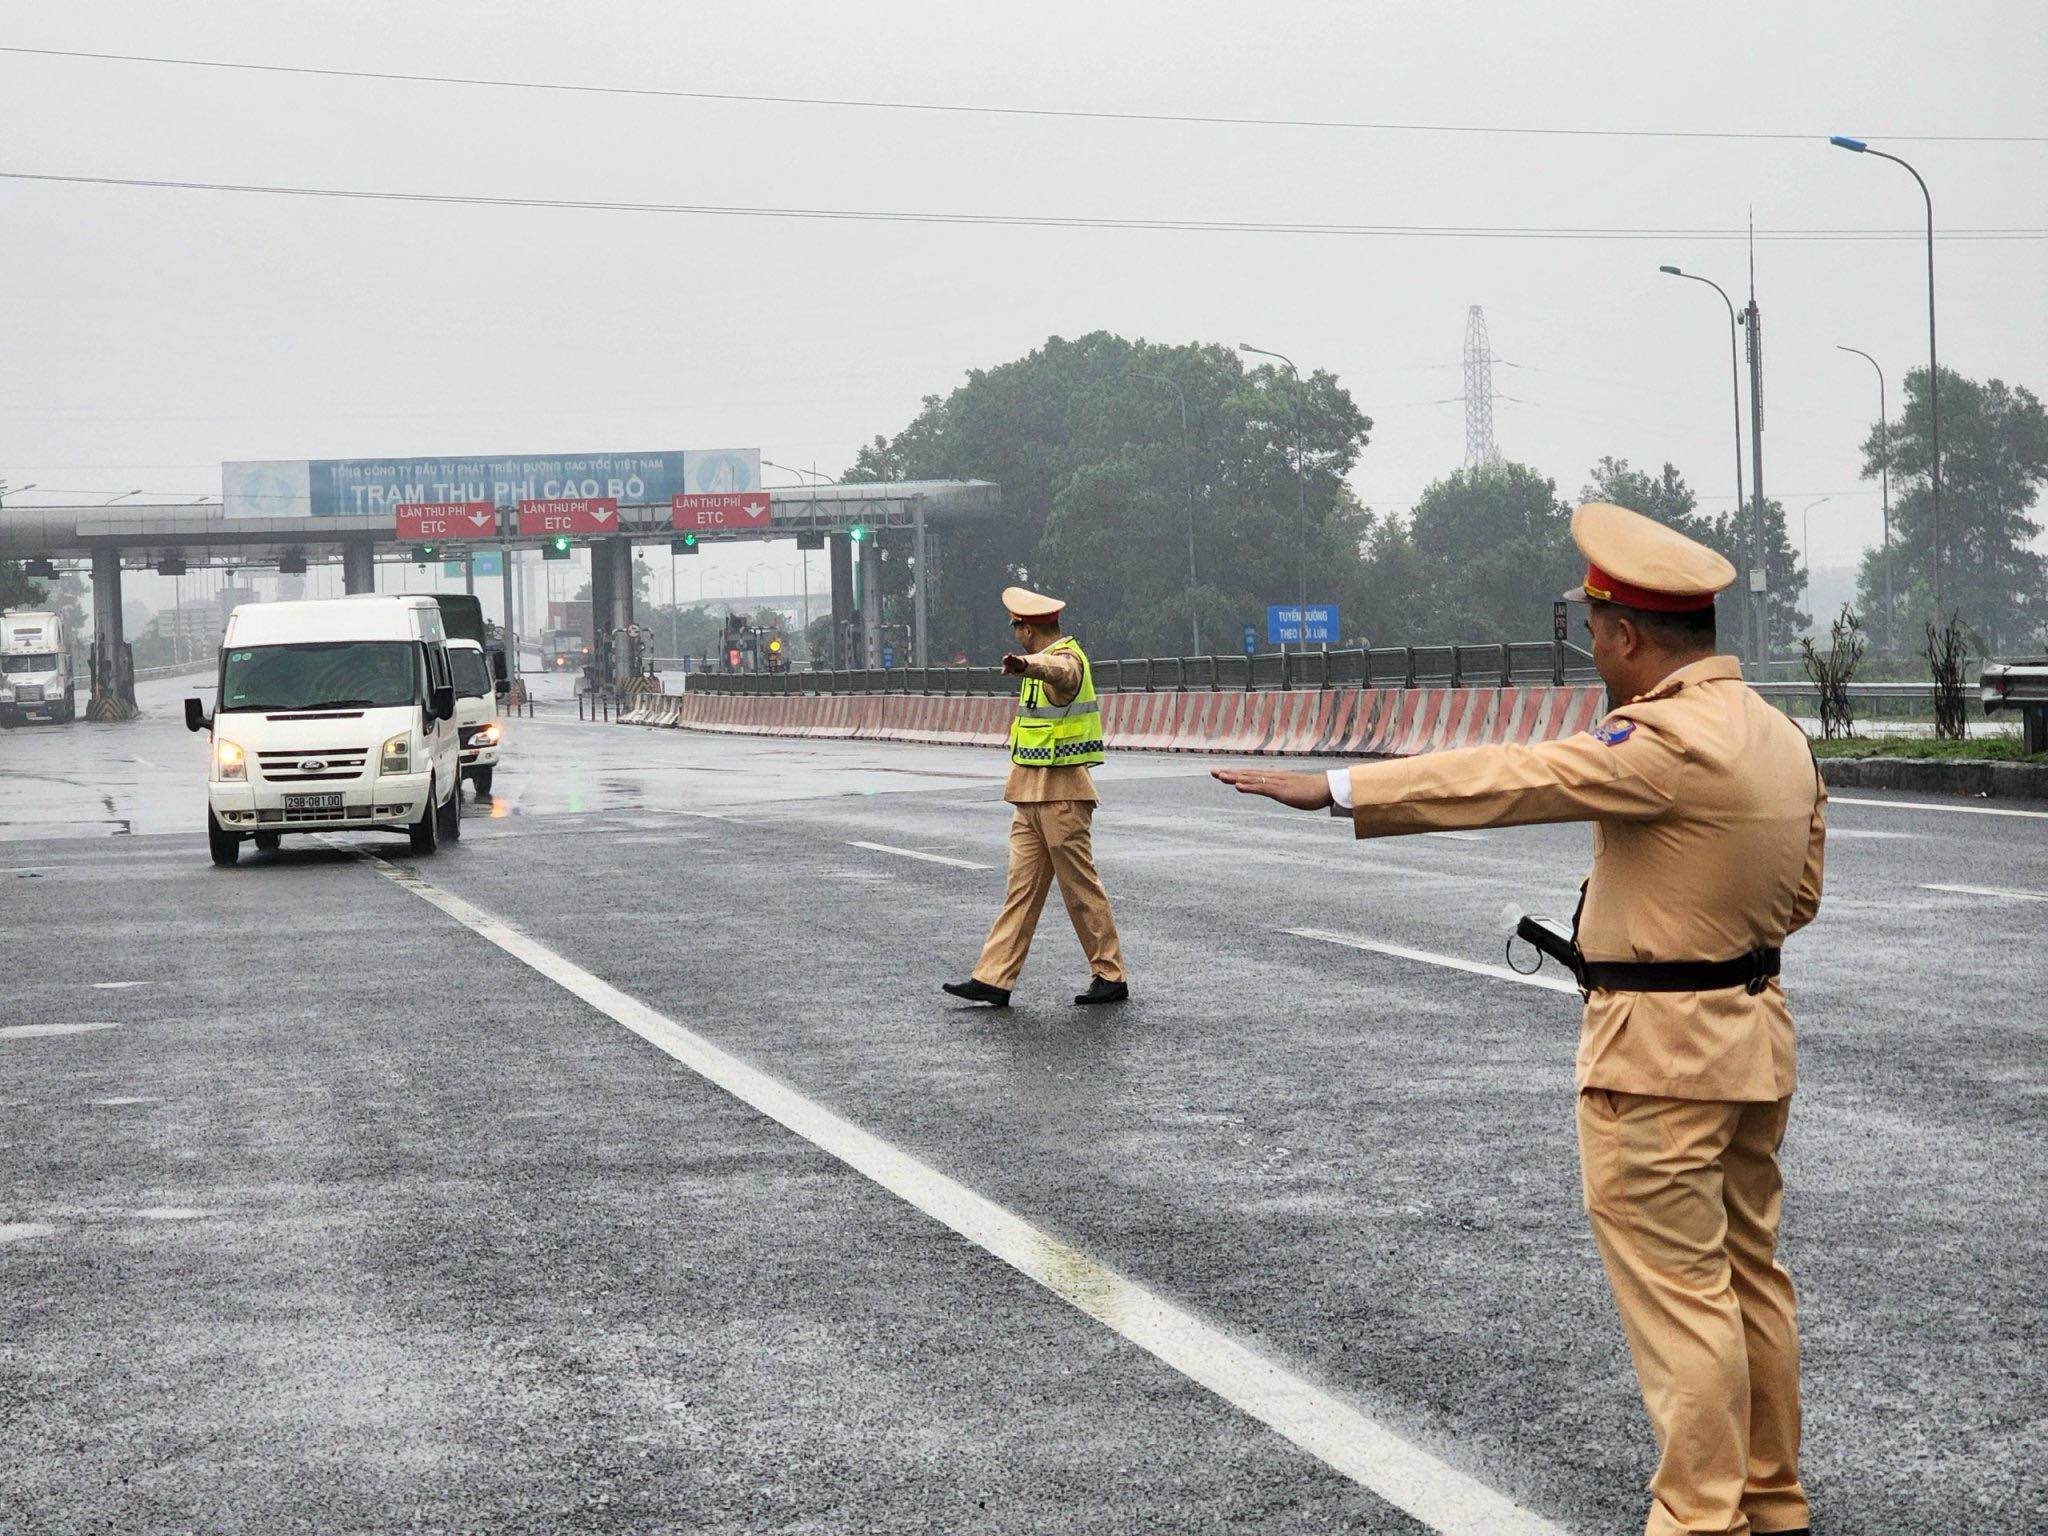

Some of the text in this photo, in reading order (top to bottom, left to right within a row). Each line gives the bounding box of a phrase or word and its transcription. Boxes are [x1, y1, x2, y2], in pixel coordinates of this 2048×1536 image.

[364, 465, 395, 476] CÔNG
[399, 464, 412, 475] TY
[565, 461, 587, 471] CAO
[640, 458, 663, 470] NAM
[432, 482, 485, 503] THU
[494, 475, 535, 502] PHÍ
[543, 479, 600, 499] CAO
[523, 500, 588, 514] LÀN THU PHÍ
[676, 495, 741, 508] LÀN THU PHÍ
[400, 504, 466, 518] LÀN THU PHÍ
[697, 511, 724, 524] ETC
[421, 520, 447, 533] ETC
[545, 517, 571, 530] ETC
[1280, 628, 1298, 640] THEO
